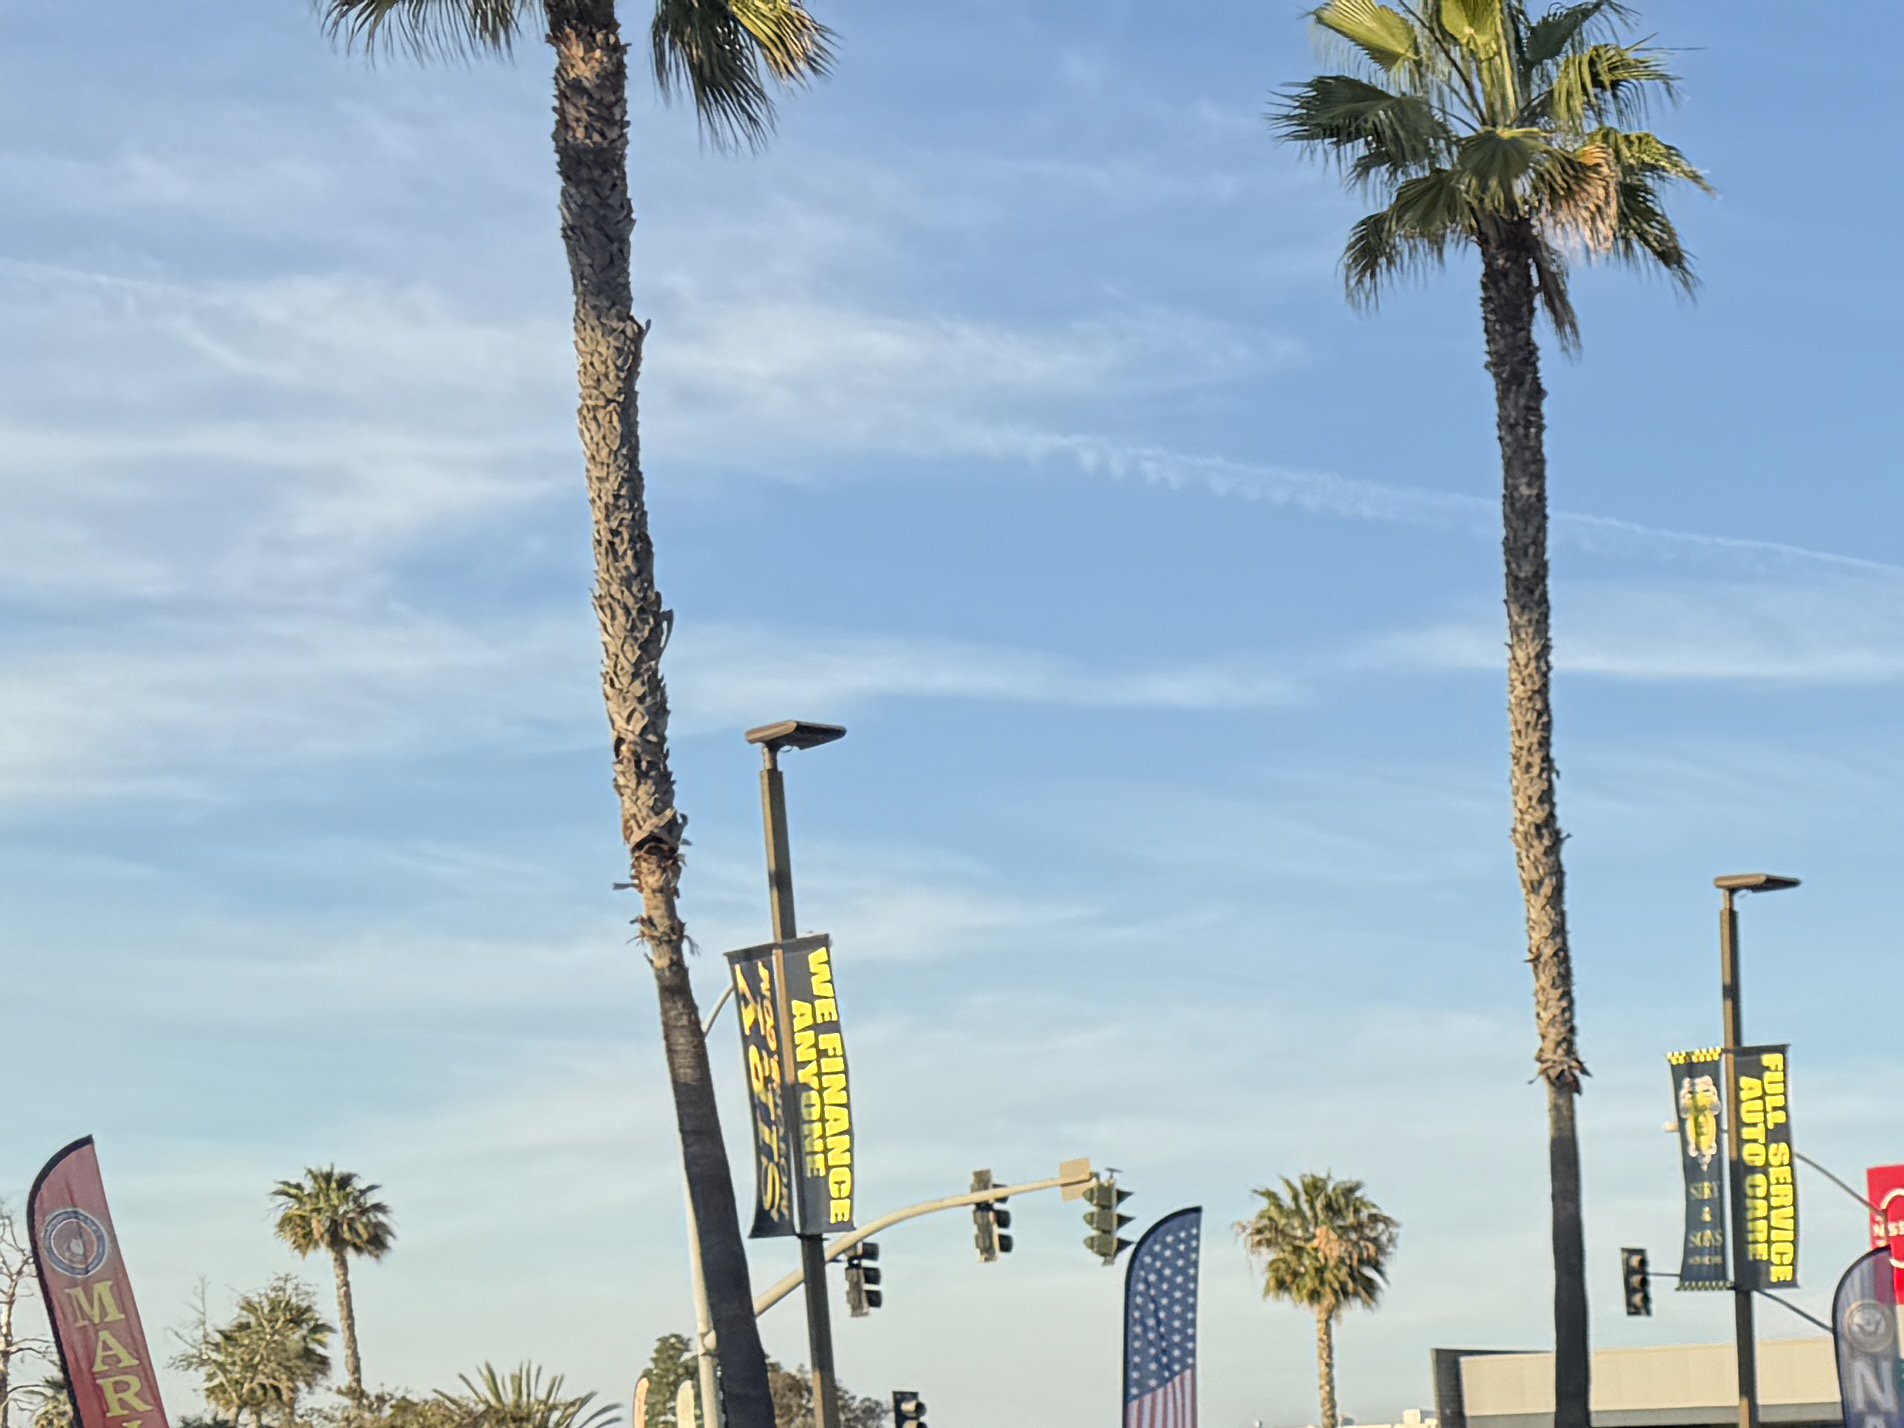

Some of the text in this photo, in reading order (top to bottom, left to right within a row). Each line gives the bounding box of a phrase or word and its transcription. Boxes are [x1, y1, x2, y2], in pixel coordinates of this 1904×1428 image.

[791, 999, 826, 1178] ANYONE
[808, 946, 852, 1224] WE FINANCE
[1739, 1076, 1769, 1262] AUTO CARE
[1761, 1053, 1795, 1283] FULL SERVICE
